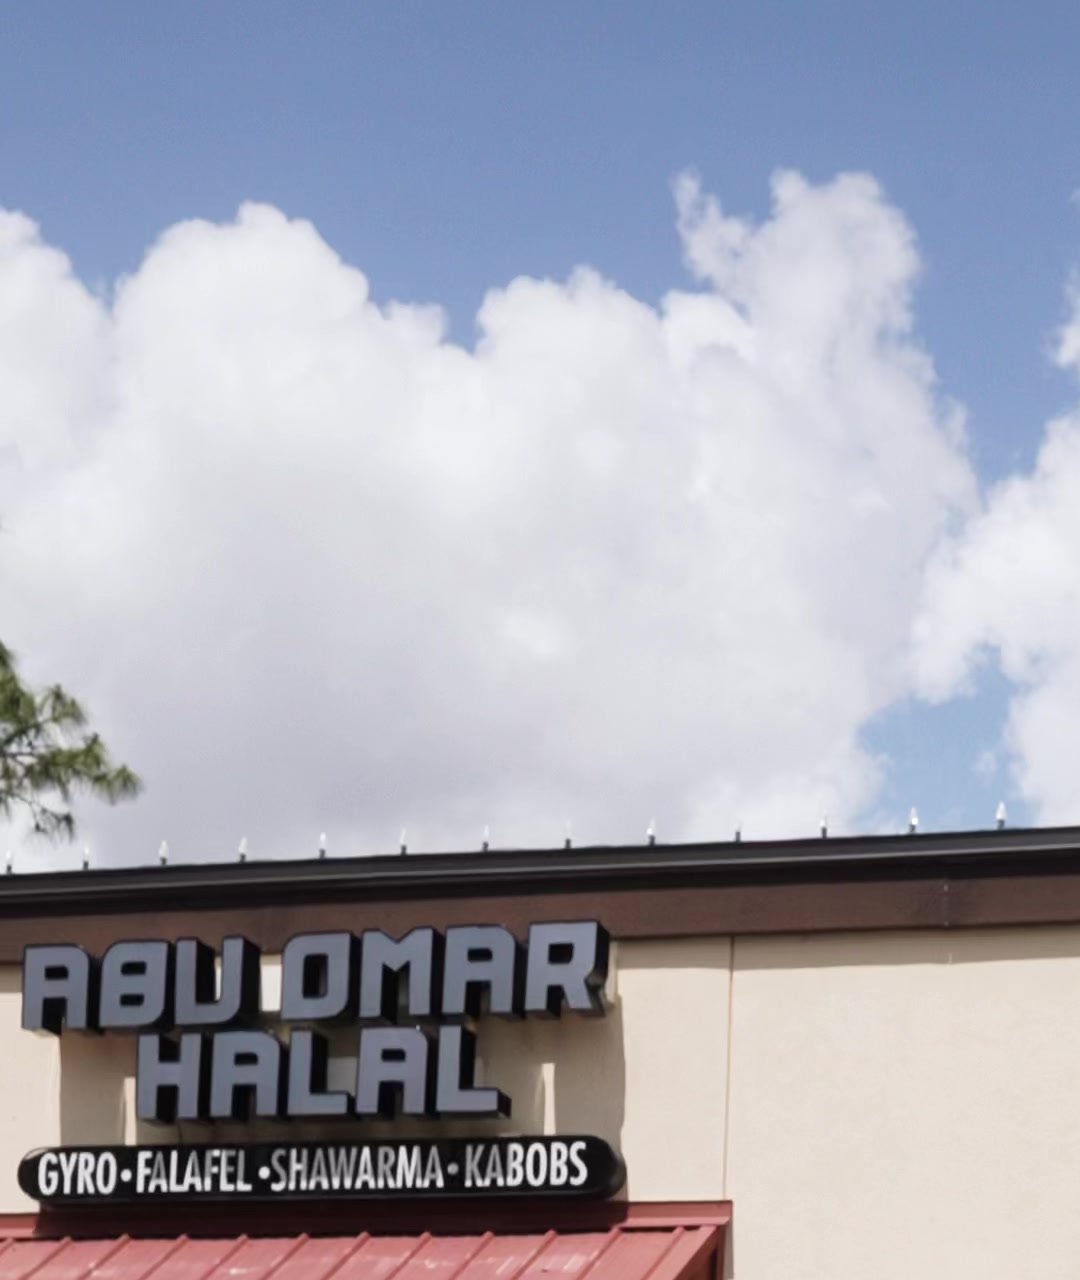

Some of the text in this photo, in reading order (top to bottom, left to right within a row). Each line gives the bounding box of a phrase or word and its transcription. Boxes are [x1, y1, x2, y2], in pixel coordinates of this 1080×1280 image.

[21, 920, 603, 1031] ABU OMAR
[135, 1024, 502, 1118] HALAL
[37, 1140, 588, 1196] GYRO FALAFEL SHAWARMA KABOBS
